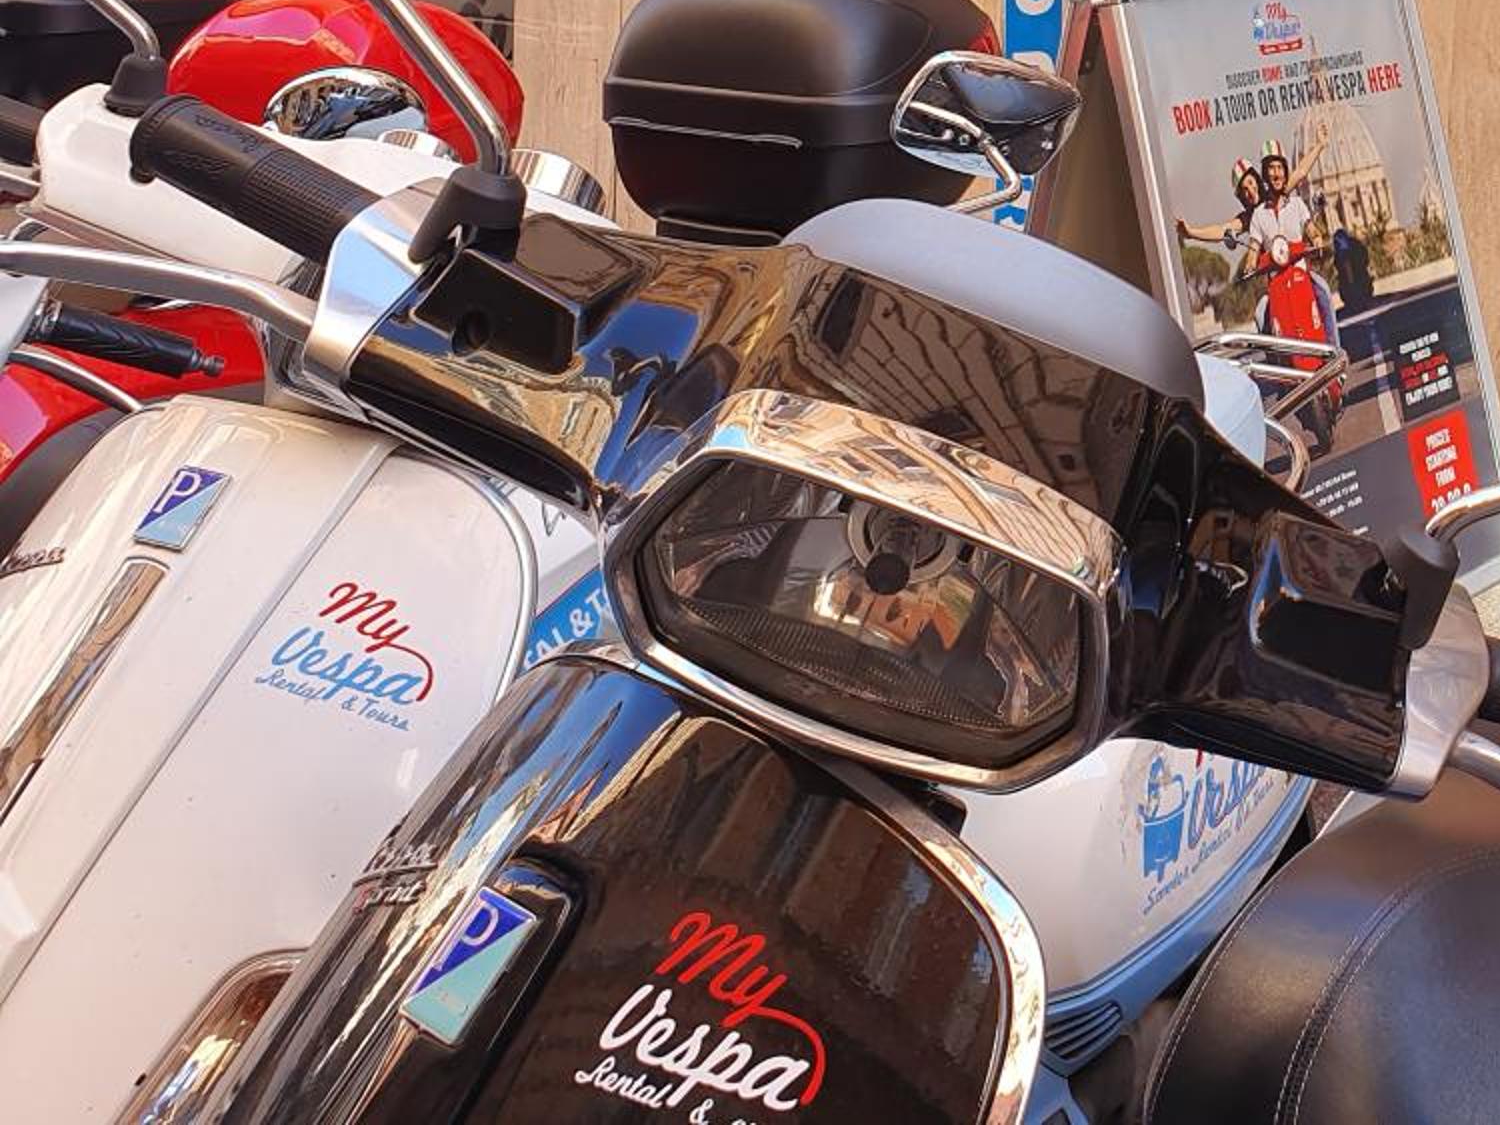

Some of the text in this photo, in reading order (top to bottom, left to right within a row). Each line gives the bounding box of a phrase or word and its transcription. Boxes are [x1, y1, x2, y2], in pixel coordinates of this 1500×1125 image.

[1172, 62, 1403, 135] BOOK A TOUR OR RENT A VESPA HERE
[316, 581, 425, 670] My
[256, 670, 328, 705] Rental
[357, 695, 410, 732] Tours
[271, 626, 421, 705] Vespa
[655, 911, 806, 1062] My
[574, 1056, 674, 1110] Rental
[598, 983, 812, 1112] Vespa
